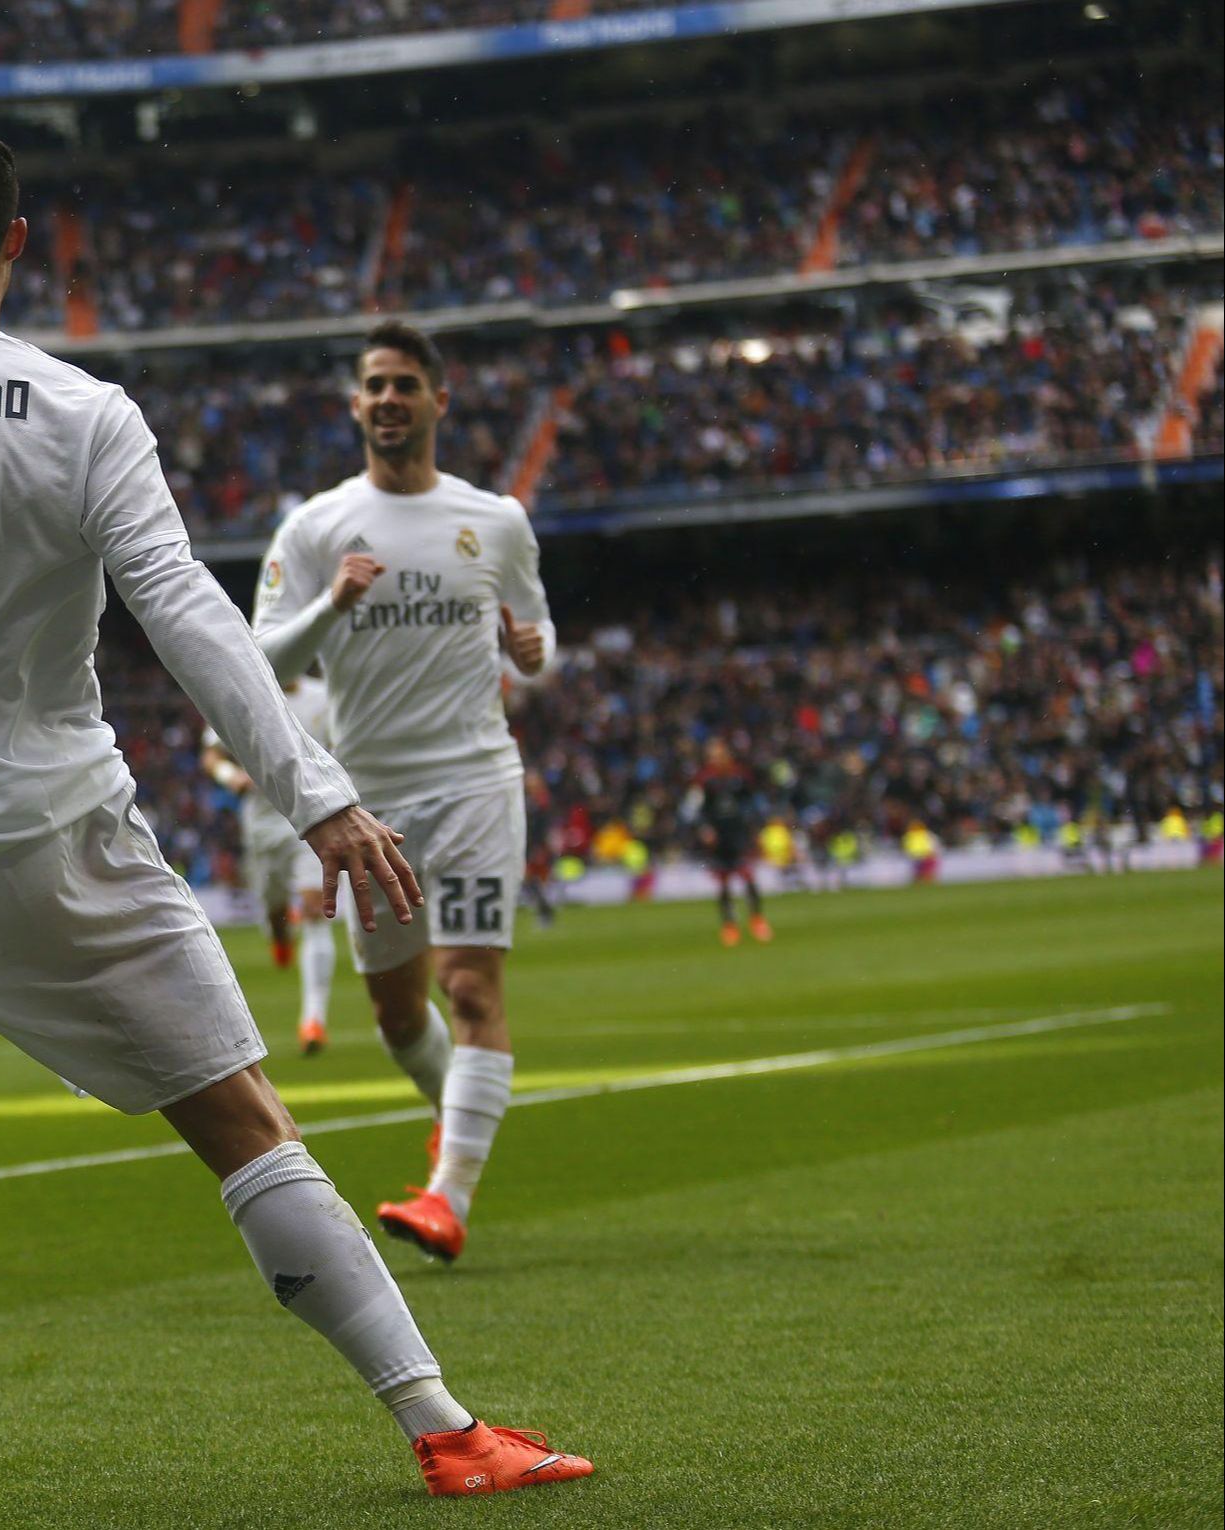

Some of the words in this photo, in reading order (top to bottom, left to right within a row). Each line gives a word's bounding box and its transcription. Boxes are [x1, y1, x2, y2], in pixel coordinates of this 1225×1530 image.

[398, 570, 442, 594] Fly
[440, 876, 502, 932] 22
[464, 1474, 486, 1488] CR7
